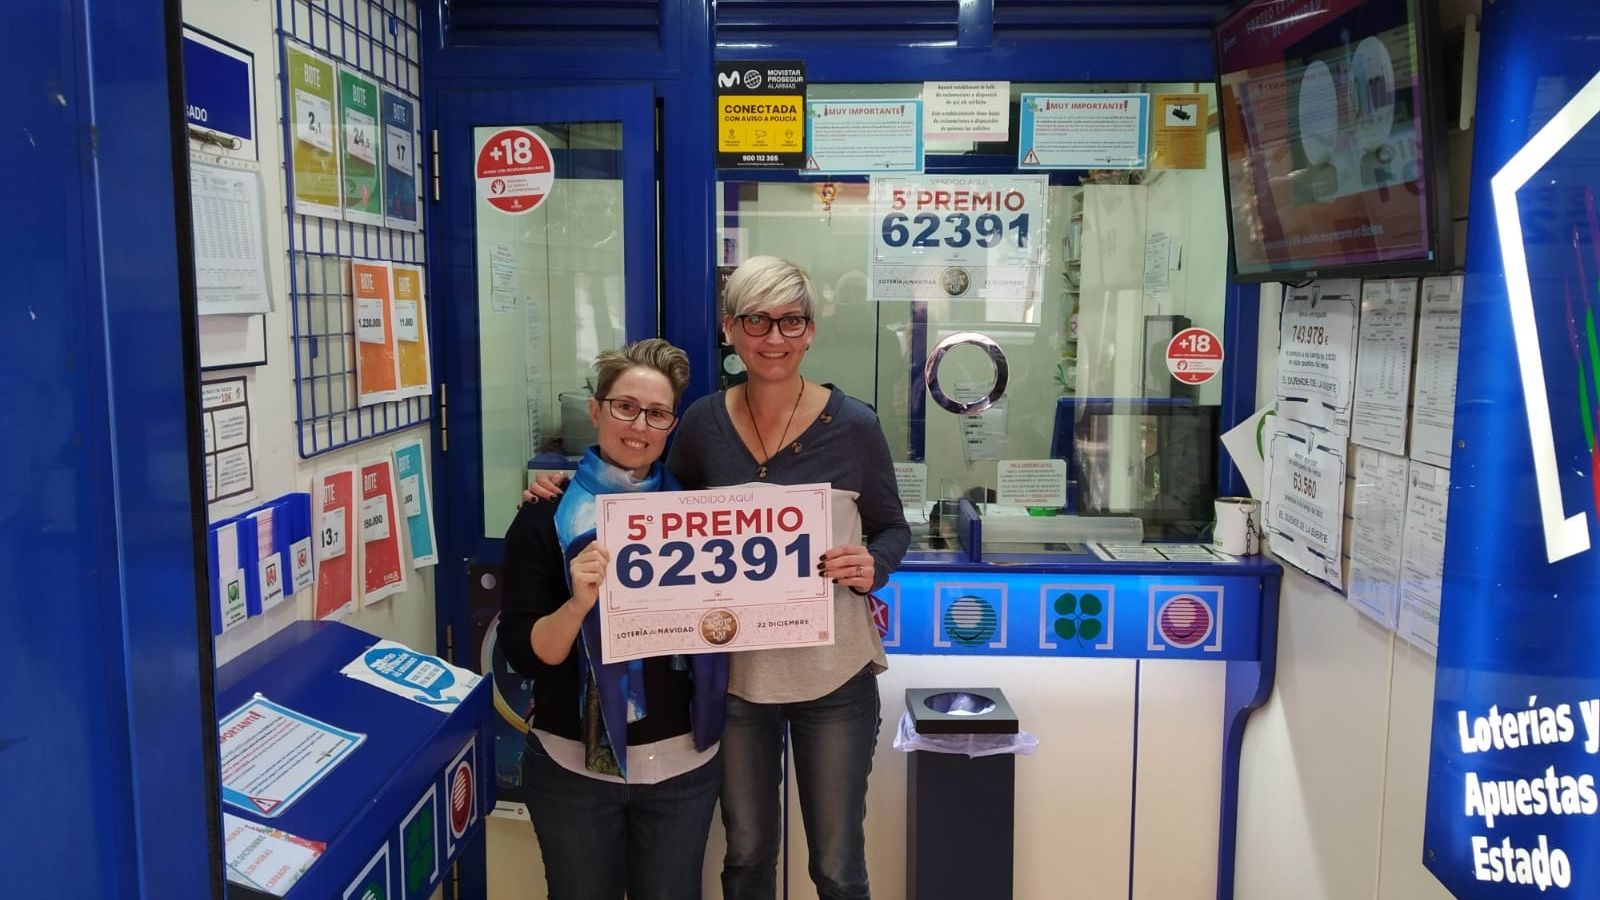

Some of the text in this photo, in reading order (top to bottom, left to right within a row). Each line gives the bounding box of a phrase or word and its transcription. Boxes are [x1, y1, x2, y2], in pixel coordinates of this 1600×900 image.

[304, 62, 321, 88] BOTE
[352, 83, 368, 105] BOTE
[186, 104, 207, 122] ADO
[393, 102, 407, 123] BOTE
[724, 104, 797, 114] CONECTADA
[770, 114, 797, 122] POLICÍA
[396, 145, 406, 162] 17
[490, 136, 533, 165] +18
[930, 178, 967, 186] VENDIDO
[917, 190, 1025, 212] PREMIO
[881, 212, 1030, 248] 62391
[360, 272, 374, 292] BOTE
[398, 276, 410, 294] BOTE
[1179, 334, 1211, 353] +18
[1292, 325, 1324, 345] 743.978
[364, 472, 377, 492] BOTE
[1293, 472, 1317, 499] 63.560
[679, 493, 754, 505] VENDIDO AQUÍ
[627, 506, 804, 541] 5º PREMIO
[616, 533, 811, 589] 62391
[616, 628, 649, 640] LOTERÍA
[658, 626, 694, 635] NAVIDAD
[757, 619, 809, 629] 22 DICIEMBRE
[1457, 695, 1600, 754] Loterías y
[1464, 764, 1599, 828] Apuestas
[1471, 834, 1572, 892] Estado
